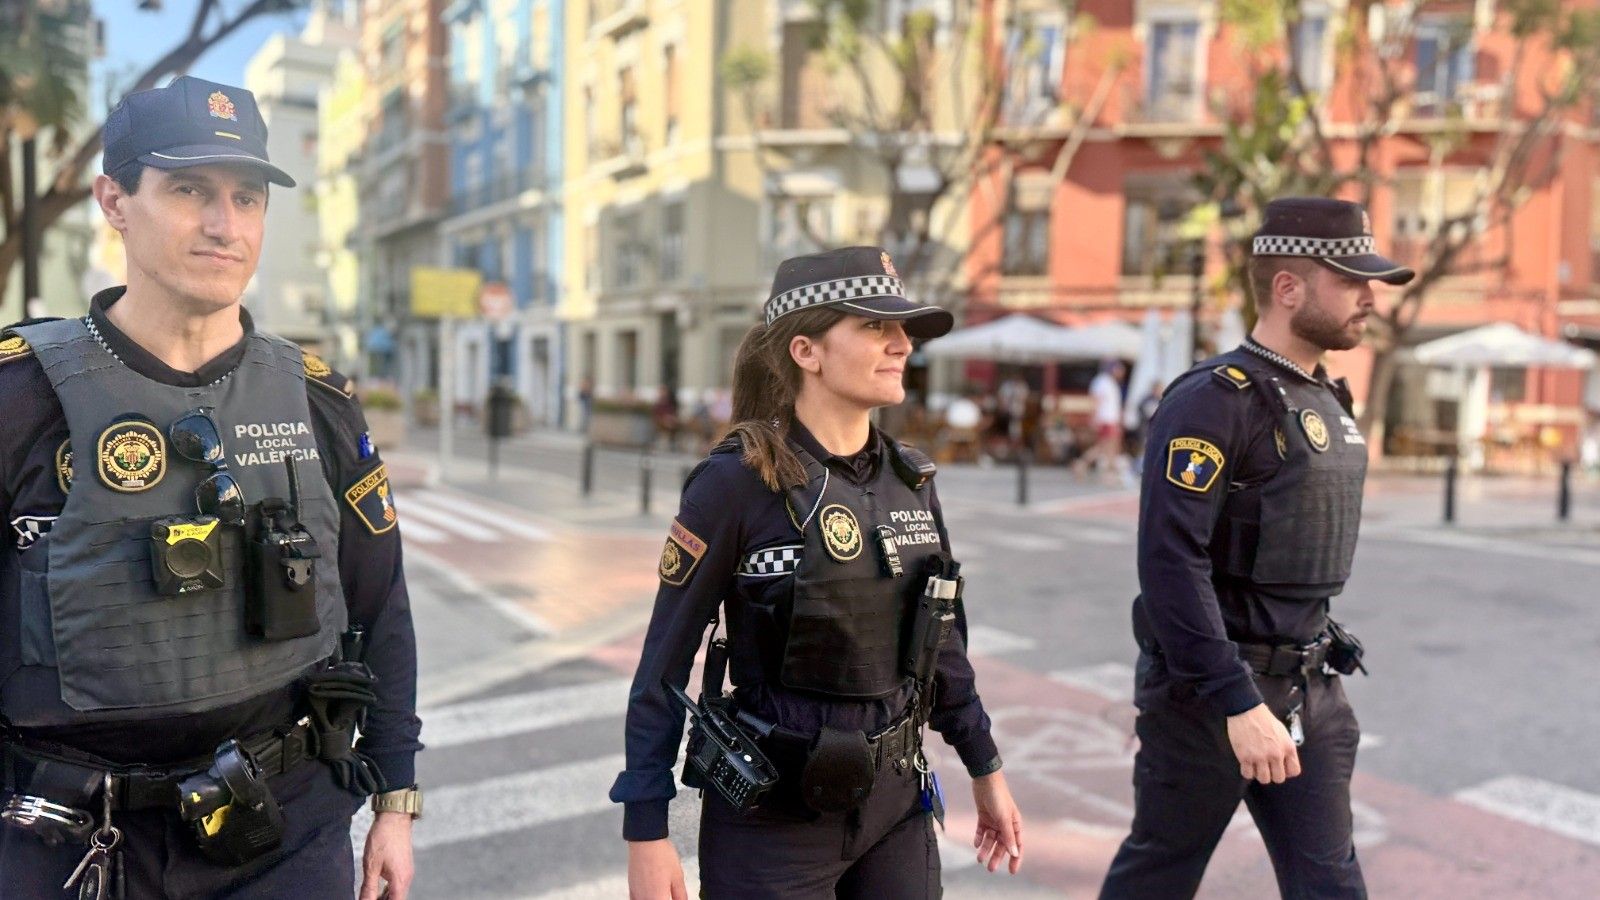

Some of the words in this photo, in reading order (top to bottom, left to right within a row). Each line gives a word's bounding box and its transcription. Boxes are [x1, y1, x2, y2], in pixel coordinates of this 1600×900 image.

[234, 422, 310, 439] POLICIA
[255, 438, 297, 449] LOCAL
[1174, 440, 1200, 449] POLICIA
[351, 475, 379, 498] POLICIA
[889, 510, 935, 522] POLICIA
[904, 523, 931, 532] LOCAL
[894, 532, 941, 546] VALÈNCI
